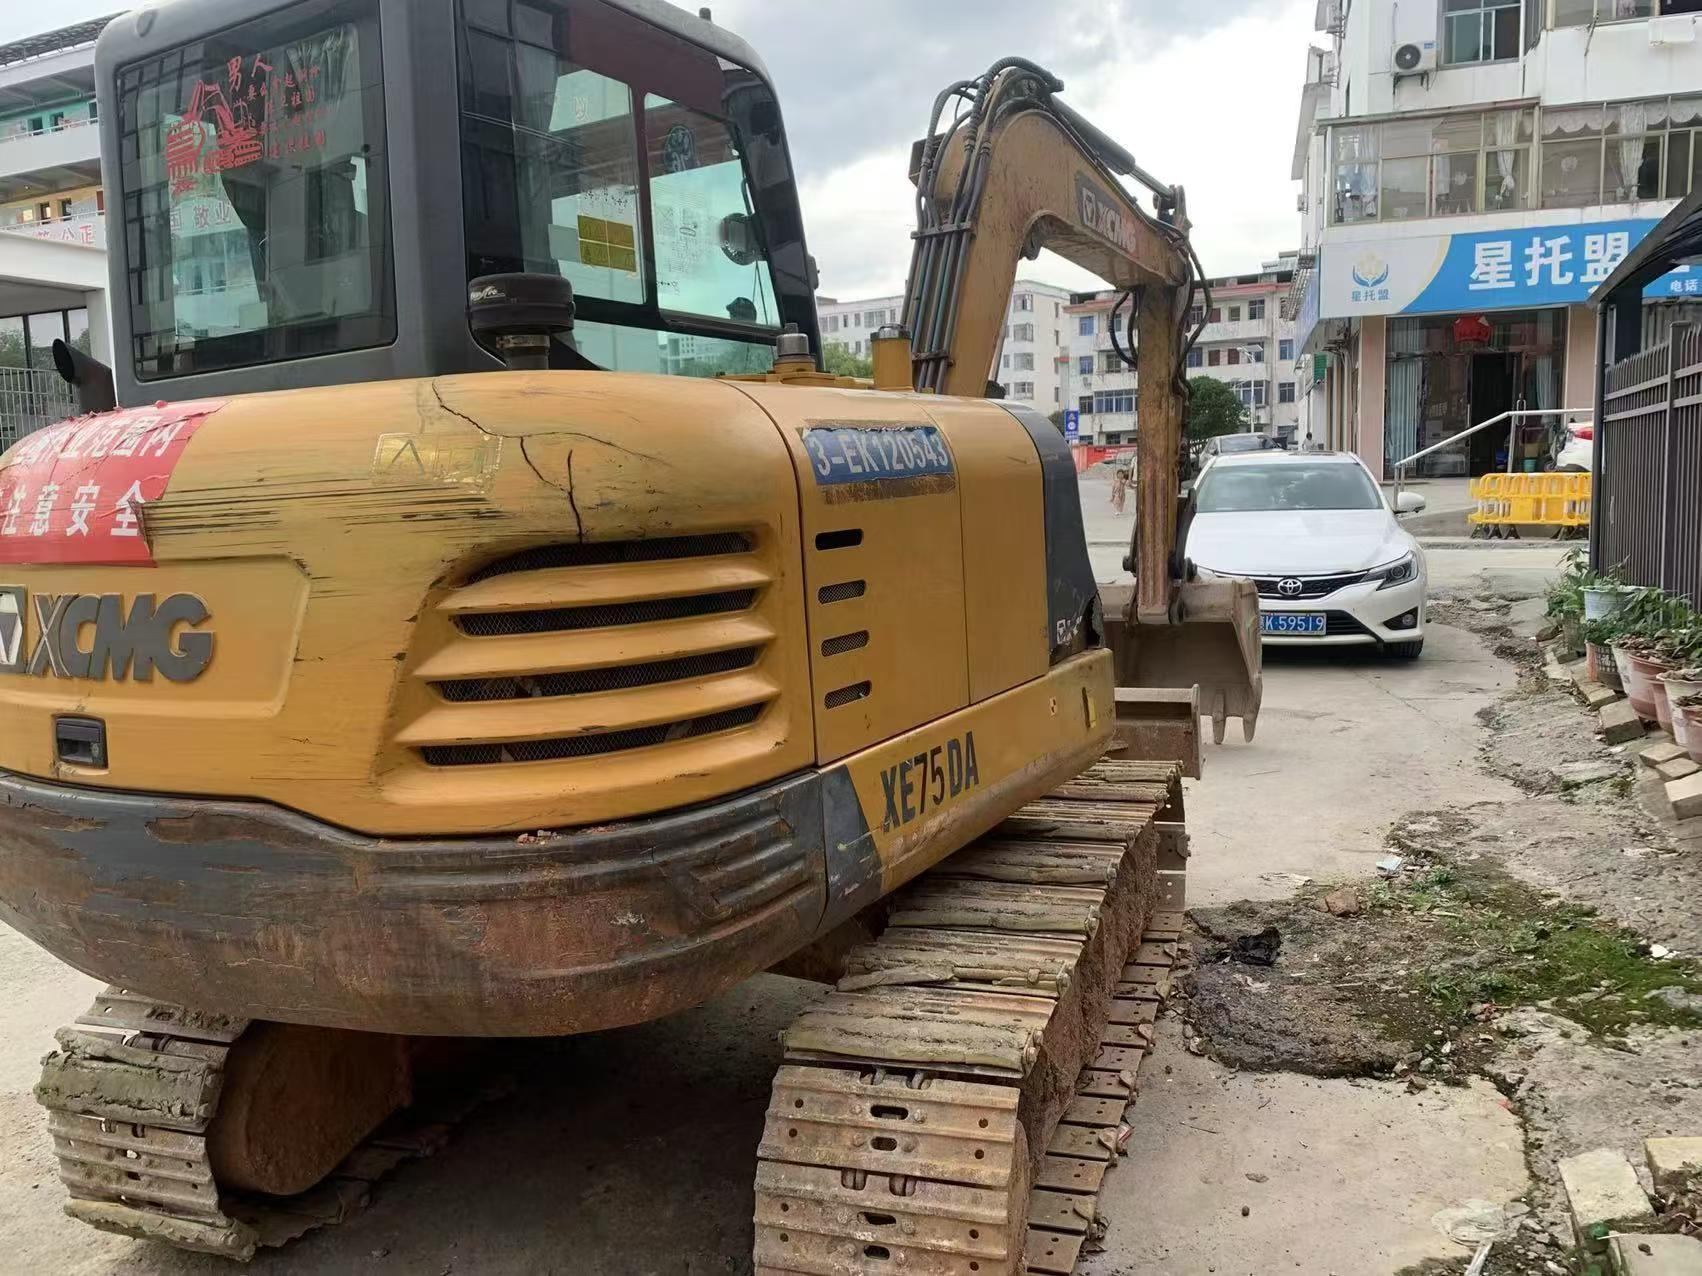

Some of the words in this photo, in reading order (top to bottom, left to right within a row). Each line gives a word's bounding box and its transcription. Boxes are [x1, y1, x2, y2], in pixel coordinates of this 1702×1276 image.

[227, 53, 273, 92] 男人
[1469, 226, 1690, 292] 星托盟
[1351, 288, 1390, 302] 星托盟
[1670, 278, 1699, 293] 电话
[808, 433, 949, 477] 3-EK120543
[0, 478, 146, 537] 注意安全
[26, 592, 214, 684] XCMG
[880, 731, 980, 833] XE75DA
